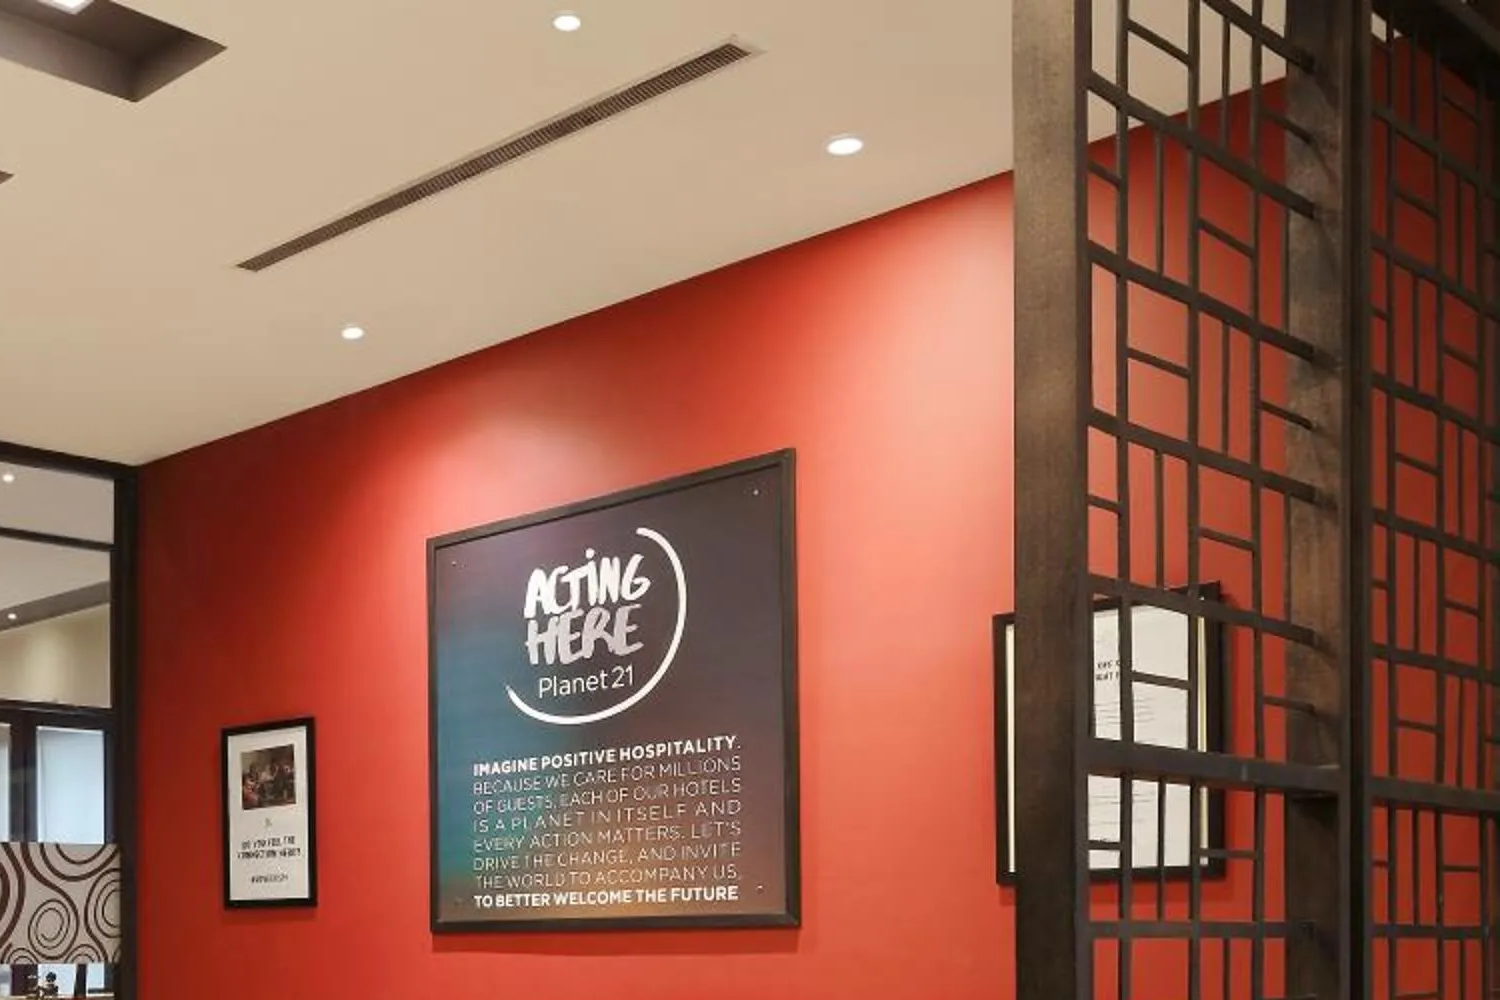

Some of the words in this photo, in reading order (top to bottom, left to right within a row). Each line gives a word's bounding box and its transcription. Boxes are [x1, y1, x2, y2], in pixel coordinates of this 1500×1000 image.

[525, 603, 644, 665] HERE
[538, 668, 608, 699] Planet
[611, 664, 635, 689] 21
[473, 757, 539, 777] IMAGINE
[541, 748, 617, 770] POSITIVE
[619, 735, 741, 761] HOSPITALITY.
[473, 775, 541, 795] BECAUSE
[544, 773, 570, 789] WE
[573, 769, 617, 787] CARE
[621, 765, 655, 782] FOR
[659, 755, 741, 777] MILLIONS
[473, 800, 493, 815] OF
[560, 790, 601, 807] EACH
[605, 787, 629, 803] OF
[633, 783, 669, 801] OUR
[673, 777, 741, 797] HOTELS
[473, 819, 489, 833] IS
[495, 819, 506, 831] A
[511, 810, 585, 831] PLANET
[591, 808, 611, 824] IN
[617, 803, 687, 823] ITSELF
[695, 799, 741, 817] AND
[473, 836, 525, 853] EVERY
[529, 831, 593, 849] ACTION
[597, 825, 685, 844] MATTERS.
[691, 821, 741, 839] LET'S
[473, 855, 521, 871] DRIVE
[524, 855, 554, 869] THE
[637, 845, 676, 862] AND
[681, 841, 741, 861] INVITE
[475, 875, 504, 889] THE
[505, 873, 566, 889] WORLD
[569, 871, 591, 885] TO
[593, 865, 709, 885] ACCOMPANY
[473, 895, 493, 909] TO
[495, 893, 550, 908] BETTER
[553, 889, 633, 905] WELCOME
[636, 887, 667, 903] THE
[671, 885, 739, 902] FUTURE
